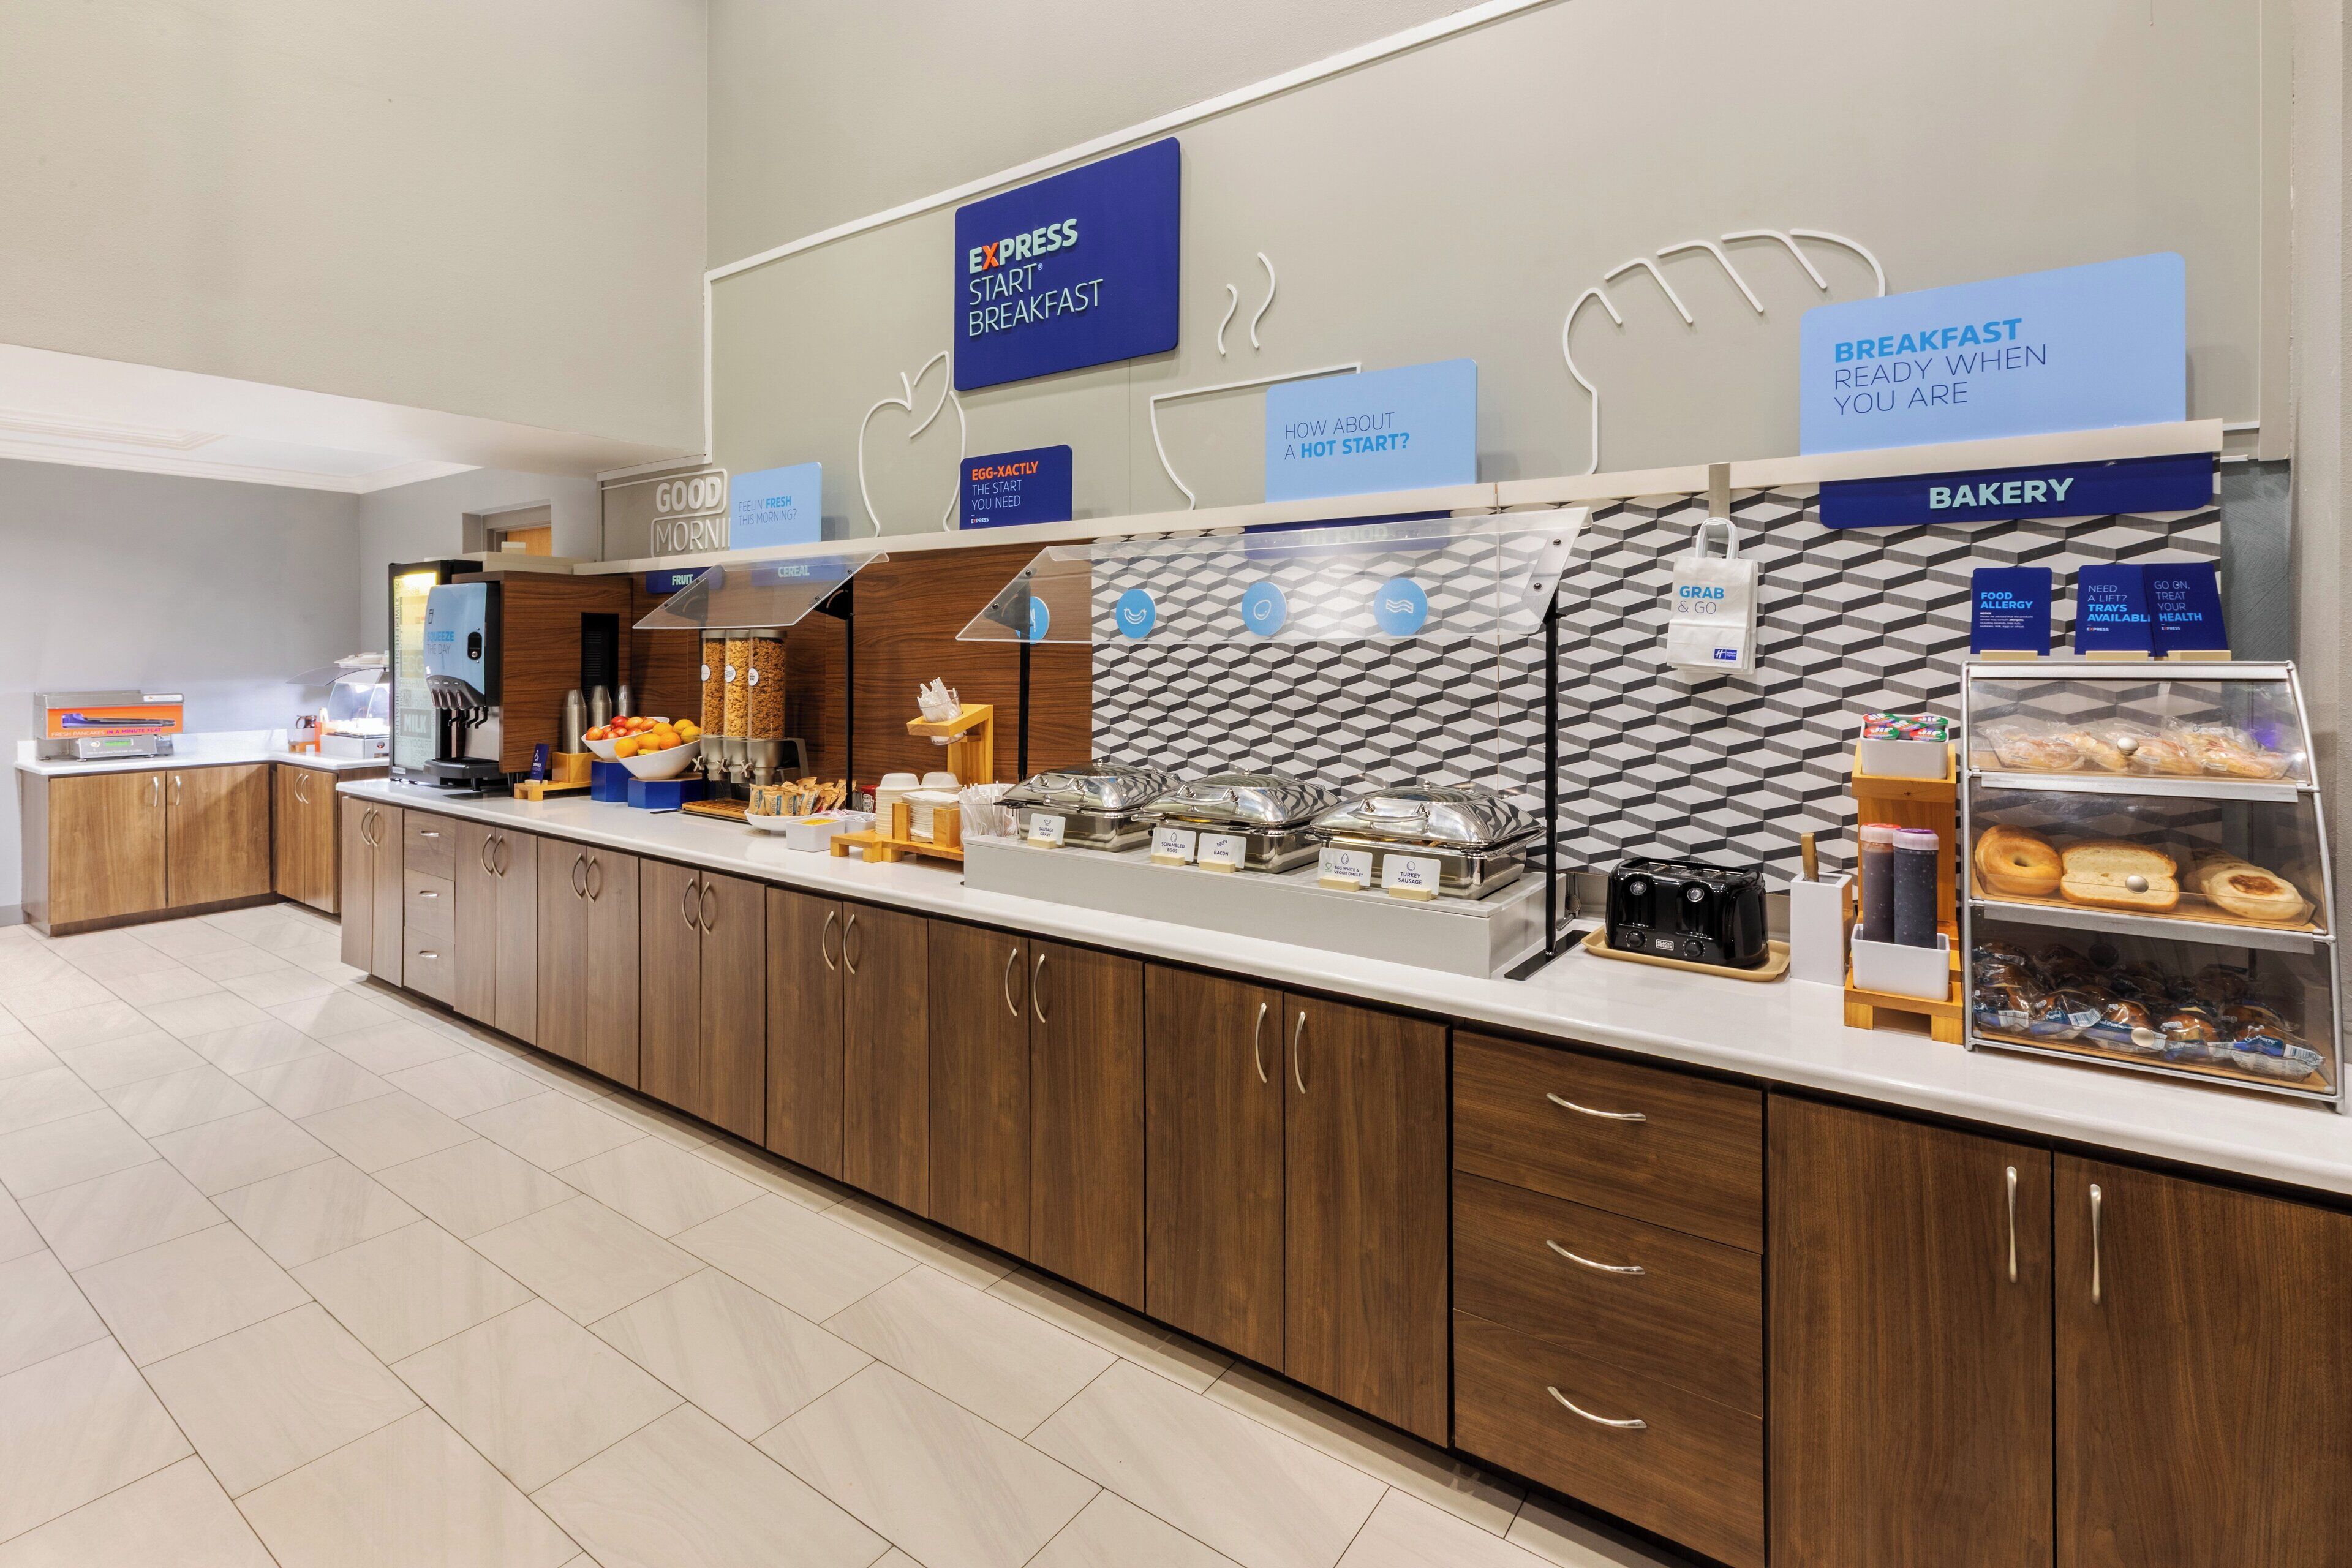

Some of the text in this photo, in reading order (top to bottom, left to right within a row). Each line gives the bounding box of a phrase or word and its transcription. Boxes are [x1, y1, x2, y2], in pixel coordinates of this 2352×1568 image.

[969, 219, 1078, 274] EXPRESS
[969, 278, 1103, 337] BREAKFAST
[1834, 317, 2022, 363] BREAKFAST
[1834, 343, 2047, 390] READY WHEN
[1834, 382, 1967, 416] YOU ARE
[1284, 412, 1395, 440] HOW ABOUT
[1284, 432, 1410, 460] A HOT START?
[972, 461, 1039, 481] EGG-XACTLY
[655, 477, 722, 513] GOOD
[971, 479, 1022, 496] THE START
[1929, 477, 2075, 510] BAKERY
[766, 495, 791, 509] FRESH
[971, 495, 1021, 510] YOU NEED
[739, 508, 797, 526] THIS MORNING?
[657, 518, 731, 552] MORNI
[778, 564, 810, 578] CEREAL
[671, 573, 693, 586] FRUIT
[2154, 581, 2169, 590] GO
[1679, 586, 1724, 600] GRAB
[2088, 584, 2117, 593] NEED
[2155, 591, 2185, 600] TREAT
[1678, 600, 1717, 614] & GO
[2157, 602, 2186, 611] YOUR
[2087, 614, 2150, 622] AVAILABL
[2159, 612, 2203, 622] HEALTH
[427, 631, 454, 642] SQUEEZE
[426, 643, 451, 654] THE DAY
[404, 714, 427, 734] MILK
